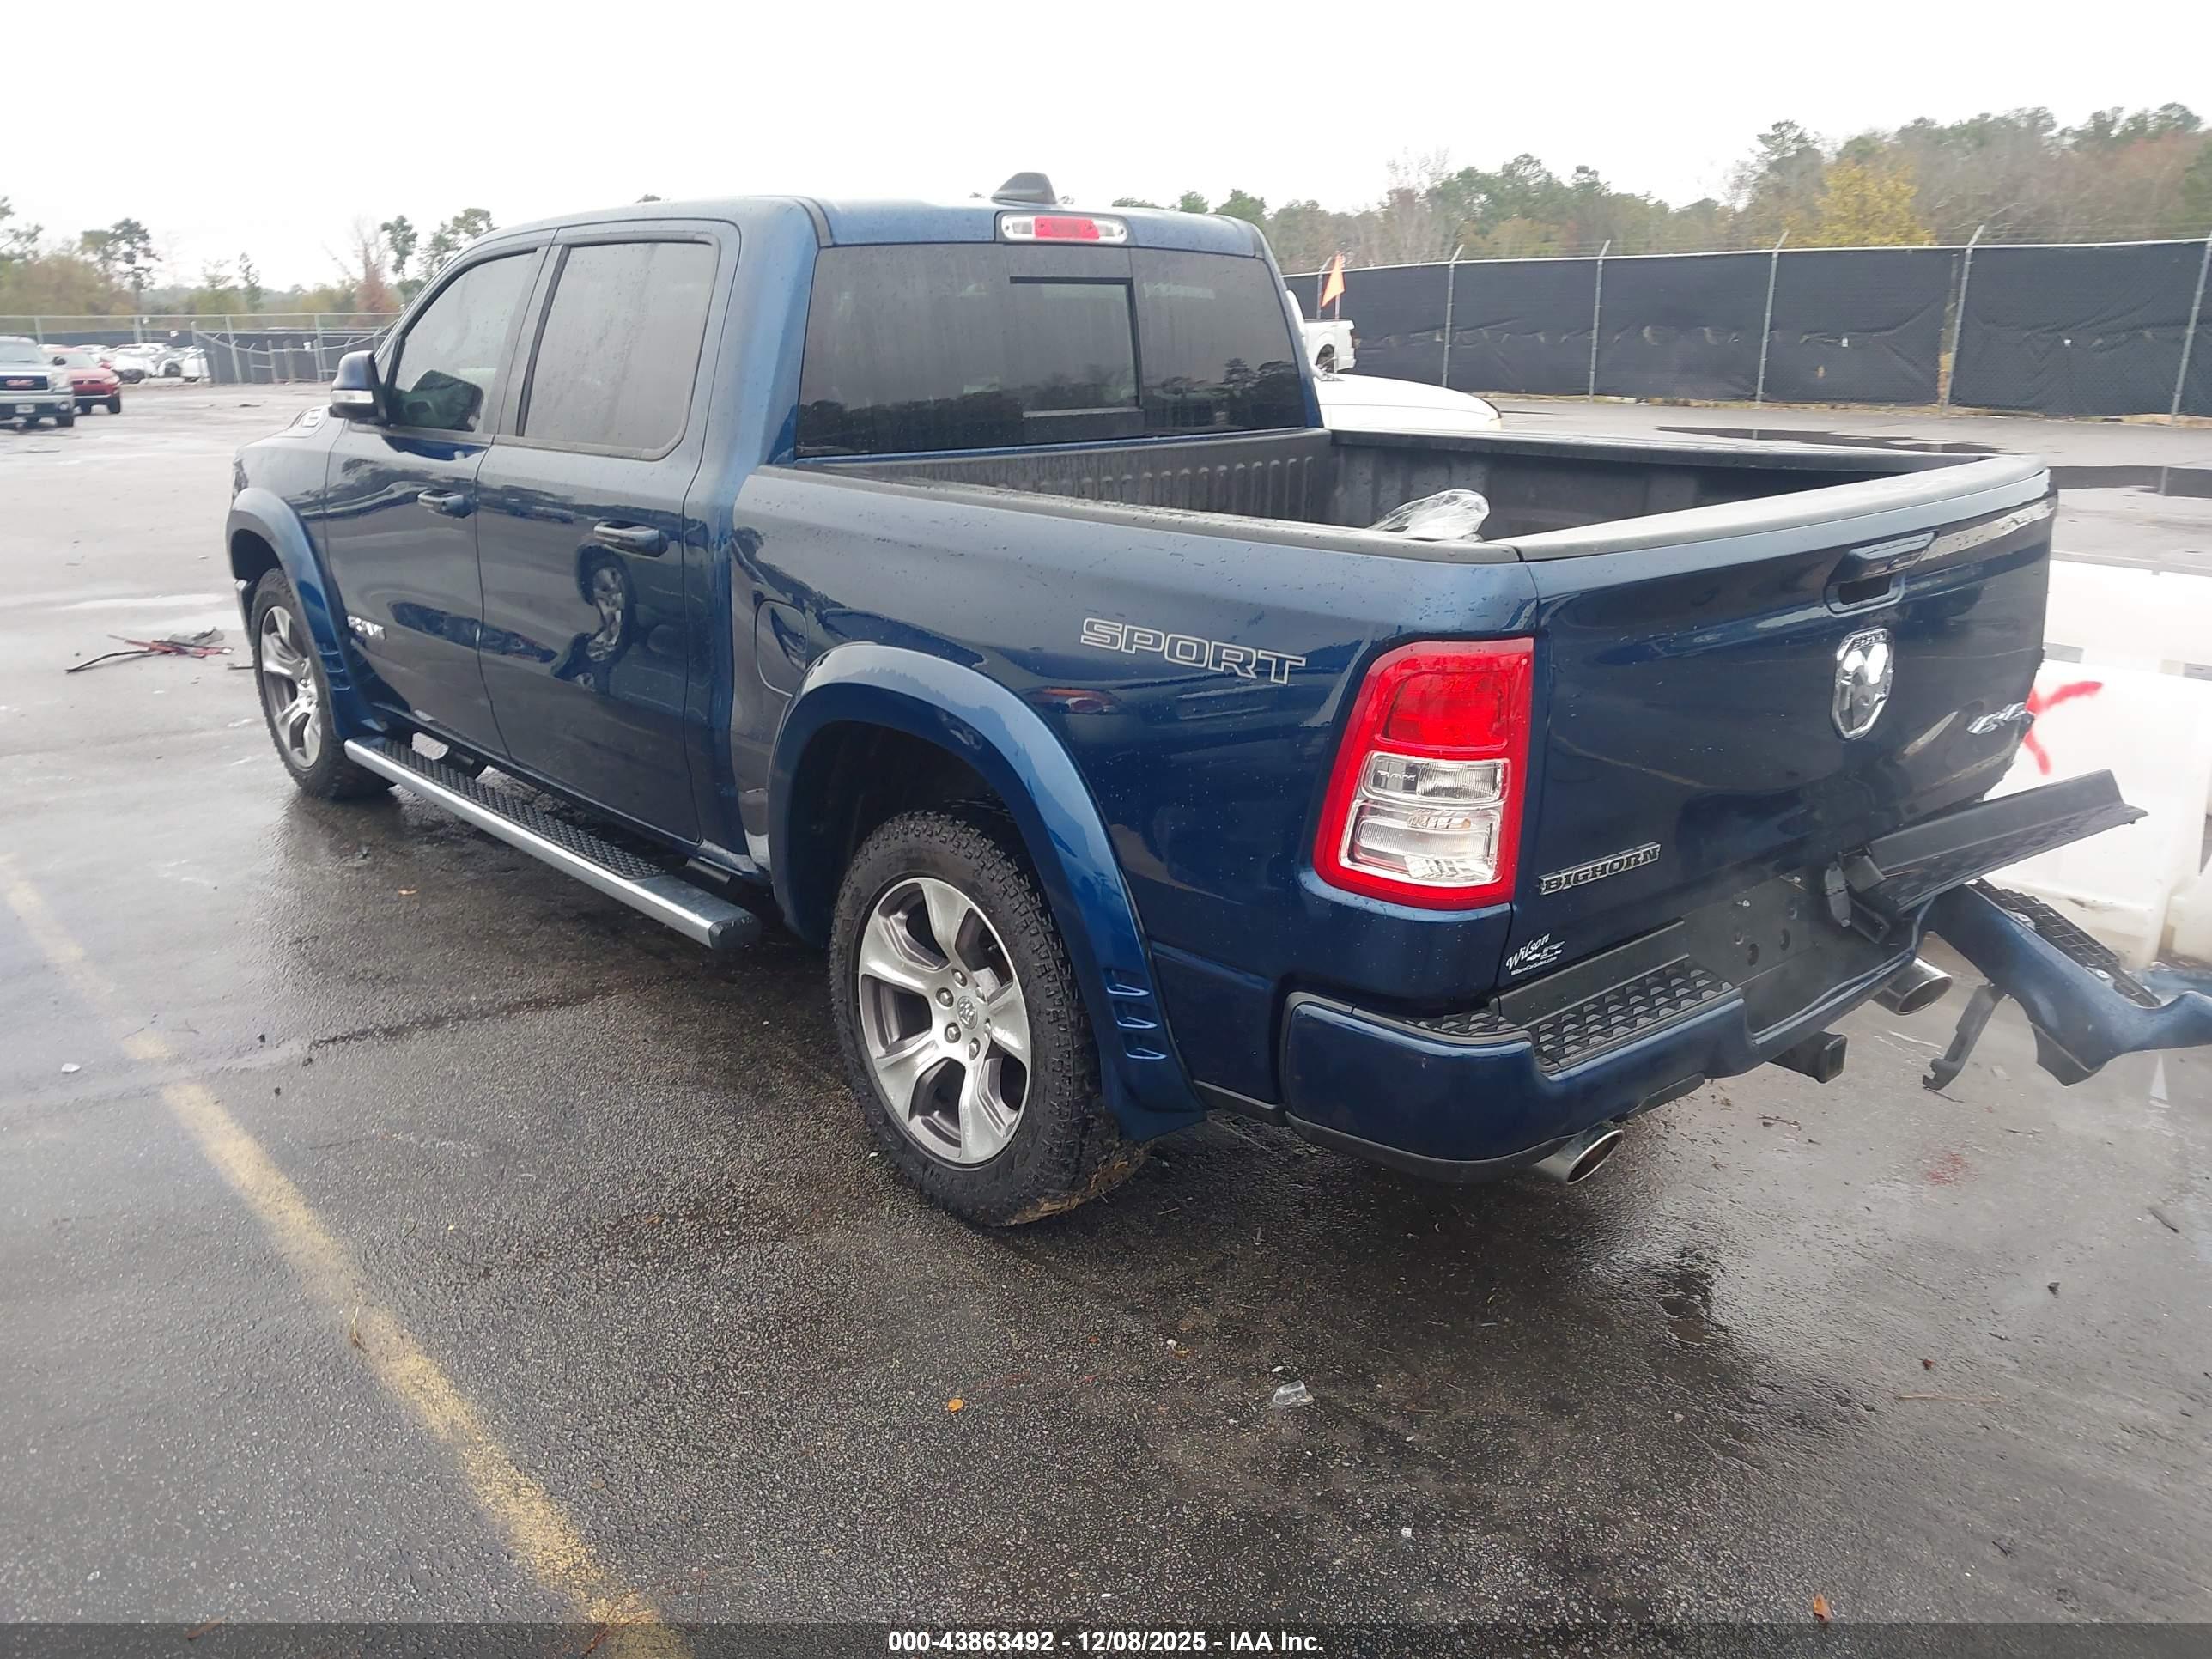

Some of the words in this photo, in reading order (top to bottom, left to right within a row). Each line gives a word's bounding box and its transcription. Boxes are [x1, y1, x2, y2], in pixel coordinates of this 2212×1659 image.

[1080, 617, 1306, 684] SPORT
[1539, 842, 1662, 896] BIGHORN
[1505, 933, 1551, 971] Wilson
